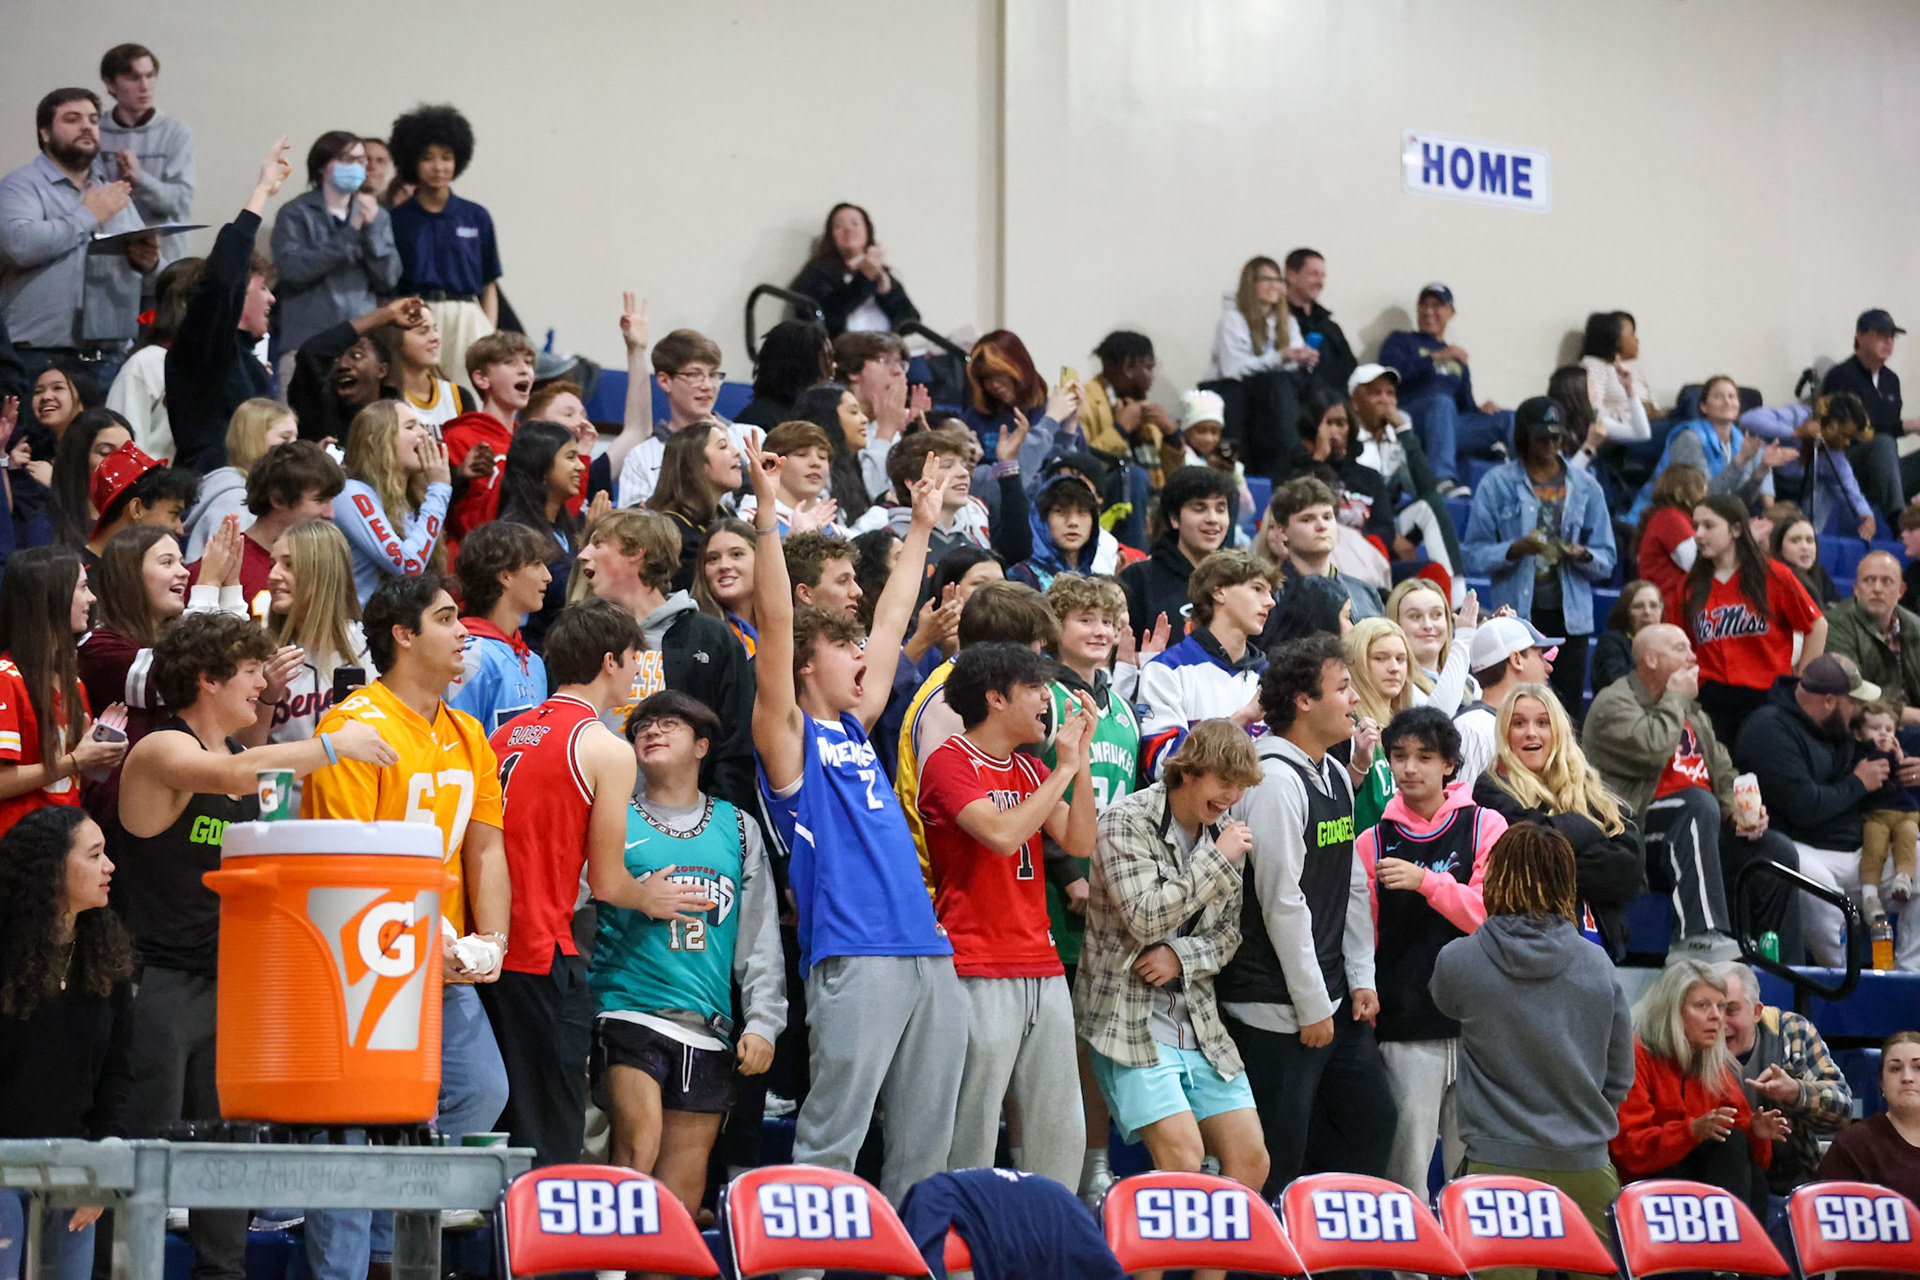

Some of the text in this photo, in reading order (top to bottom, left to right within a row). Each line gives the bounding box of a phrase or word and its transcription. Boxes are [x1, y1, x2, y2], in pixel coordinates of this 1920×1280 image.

[1422, 143, 1533, 198] HOME
[1711, 603, 1770, 641] Miss
[338, 695, 388, 720] 67
[507, 725, 551, 747] ROSE
[258, 780, 279, 813] G
[856, 769, 885, 810] 2
[358, 901, 416, 978] G
[669, 917, 706, 951] 12
[536, 1178, 661, 1236] SBA
[757, 1182, 873, 1240] SBA
[1135, 1187, 1251, 1241] SBA
[1311, 1189, 1418, 1242] SBA
[1462, 1188, 1566, 1239] SBA
[1640, 1194, 1741, 1243] SBA
[1814, 1194, 1912, 1243] SBA
